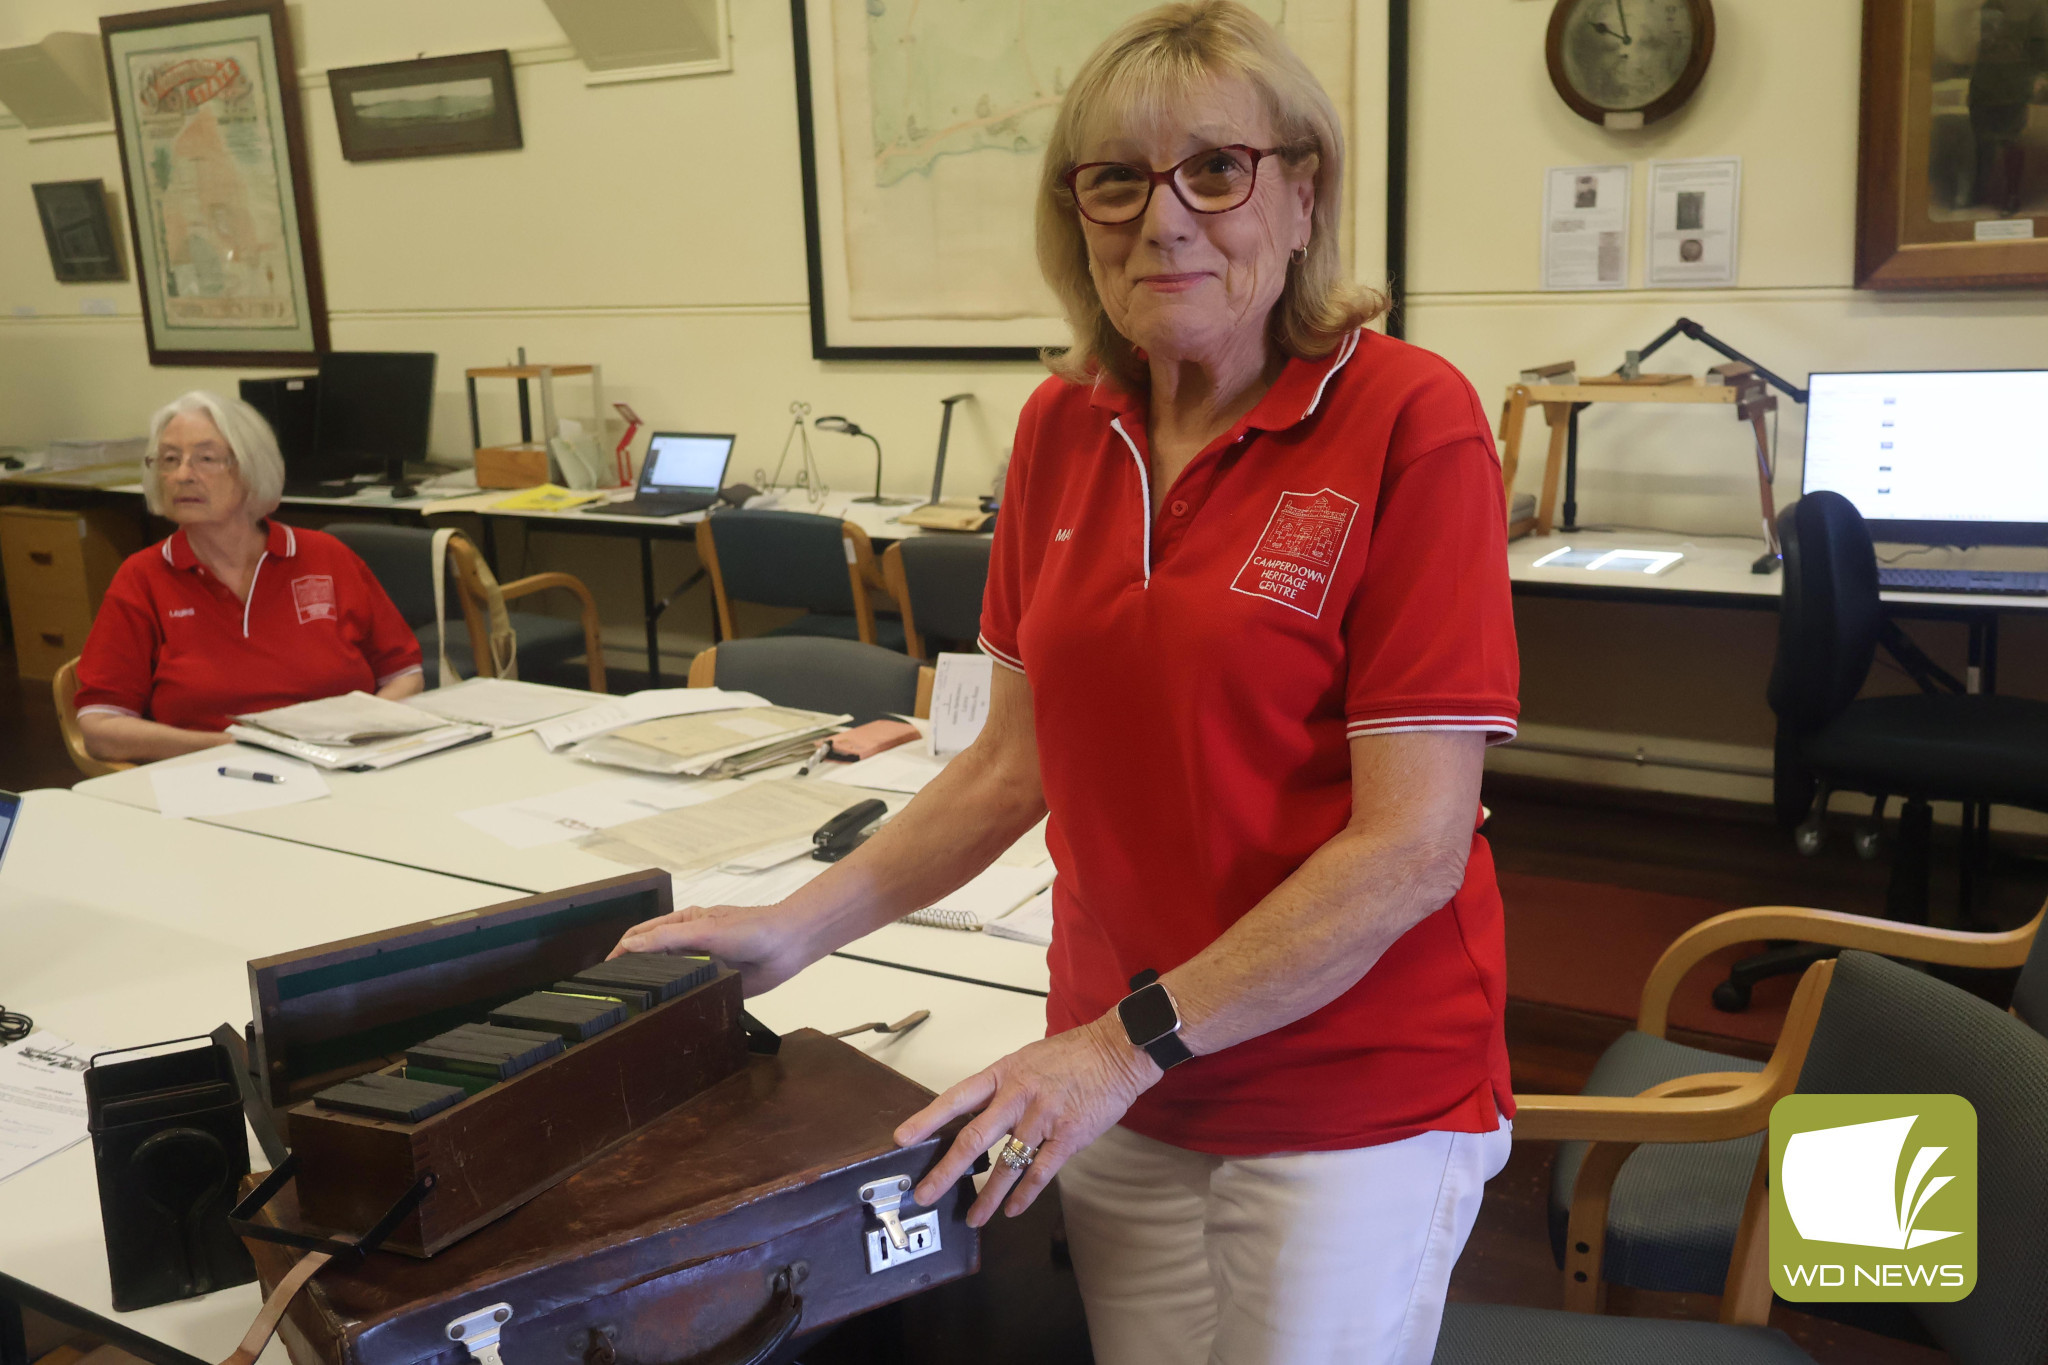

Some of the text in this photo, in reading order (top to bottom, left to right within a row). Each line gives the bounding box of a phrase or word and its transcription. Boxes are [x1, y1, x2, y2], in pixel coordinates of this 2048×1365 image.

[1253, 556, 1327, 584] CAMPERDOWN
[1261, 569, 1309, 590] HERITAGE
[1258, 580, 1298, 599] CENTRE
